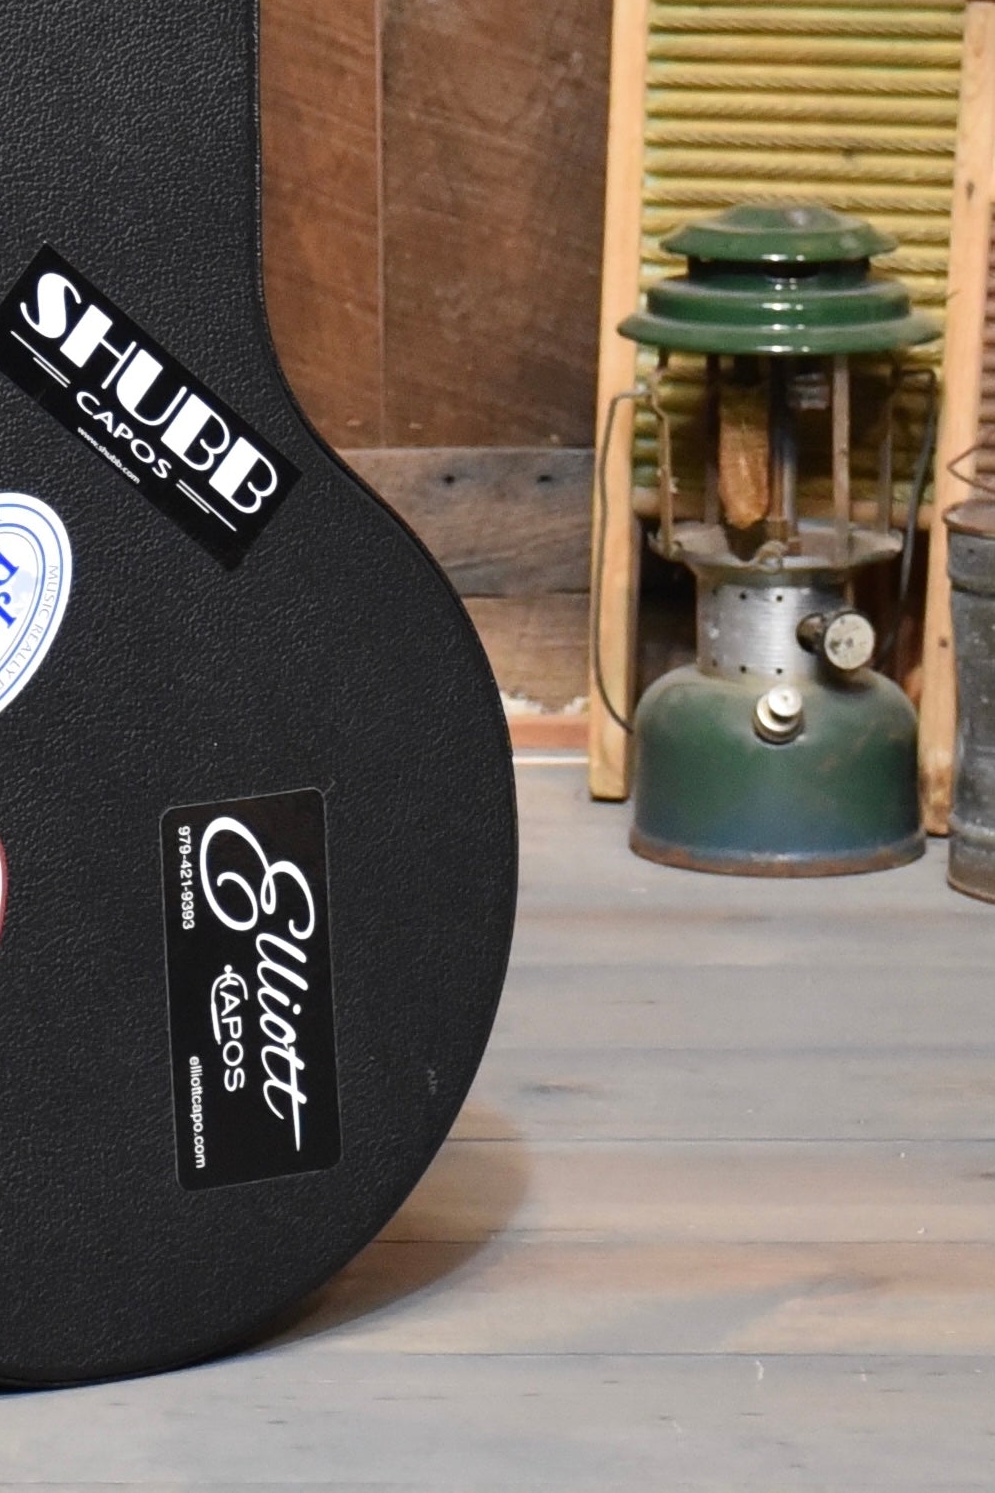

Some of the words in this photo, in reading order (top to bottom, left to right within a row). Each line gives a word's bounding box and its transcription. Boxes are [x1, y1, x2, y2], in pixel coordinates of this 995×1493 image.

[20, 272, 277, 514] SHUBB
[76, 391, 172, 479] CAPOS
[77, 426, 140, 484] www.shubb.com
[38, 565, 59, 620] MUSIC
[6, 623, 44, 679] REALLY
[178, 825, 195, 930] 979-421-9393
[199, 816, 315, 1152] Elliott
[189, 1055, 206, 1169] elliottcapo.com
